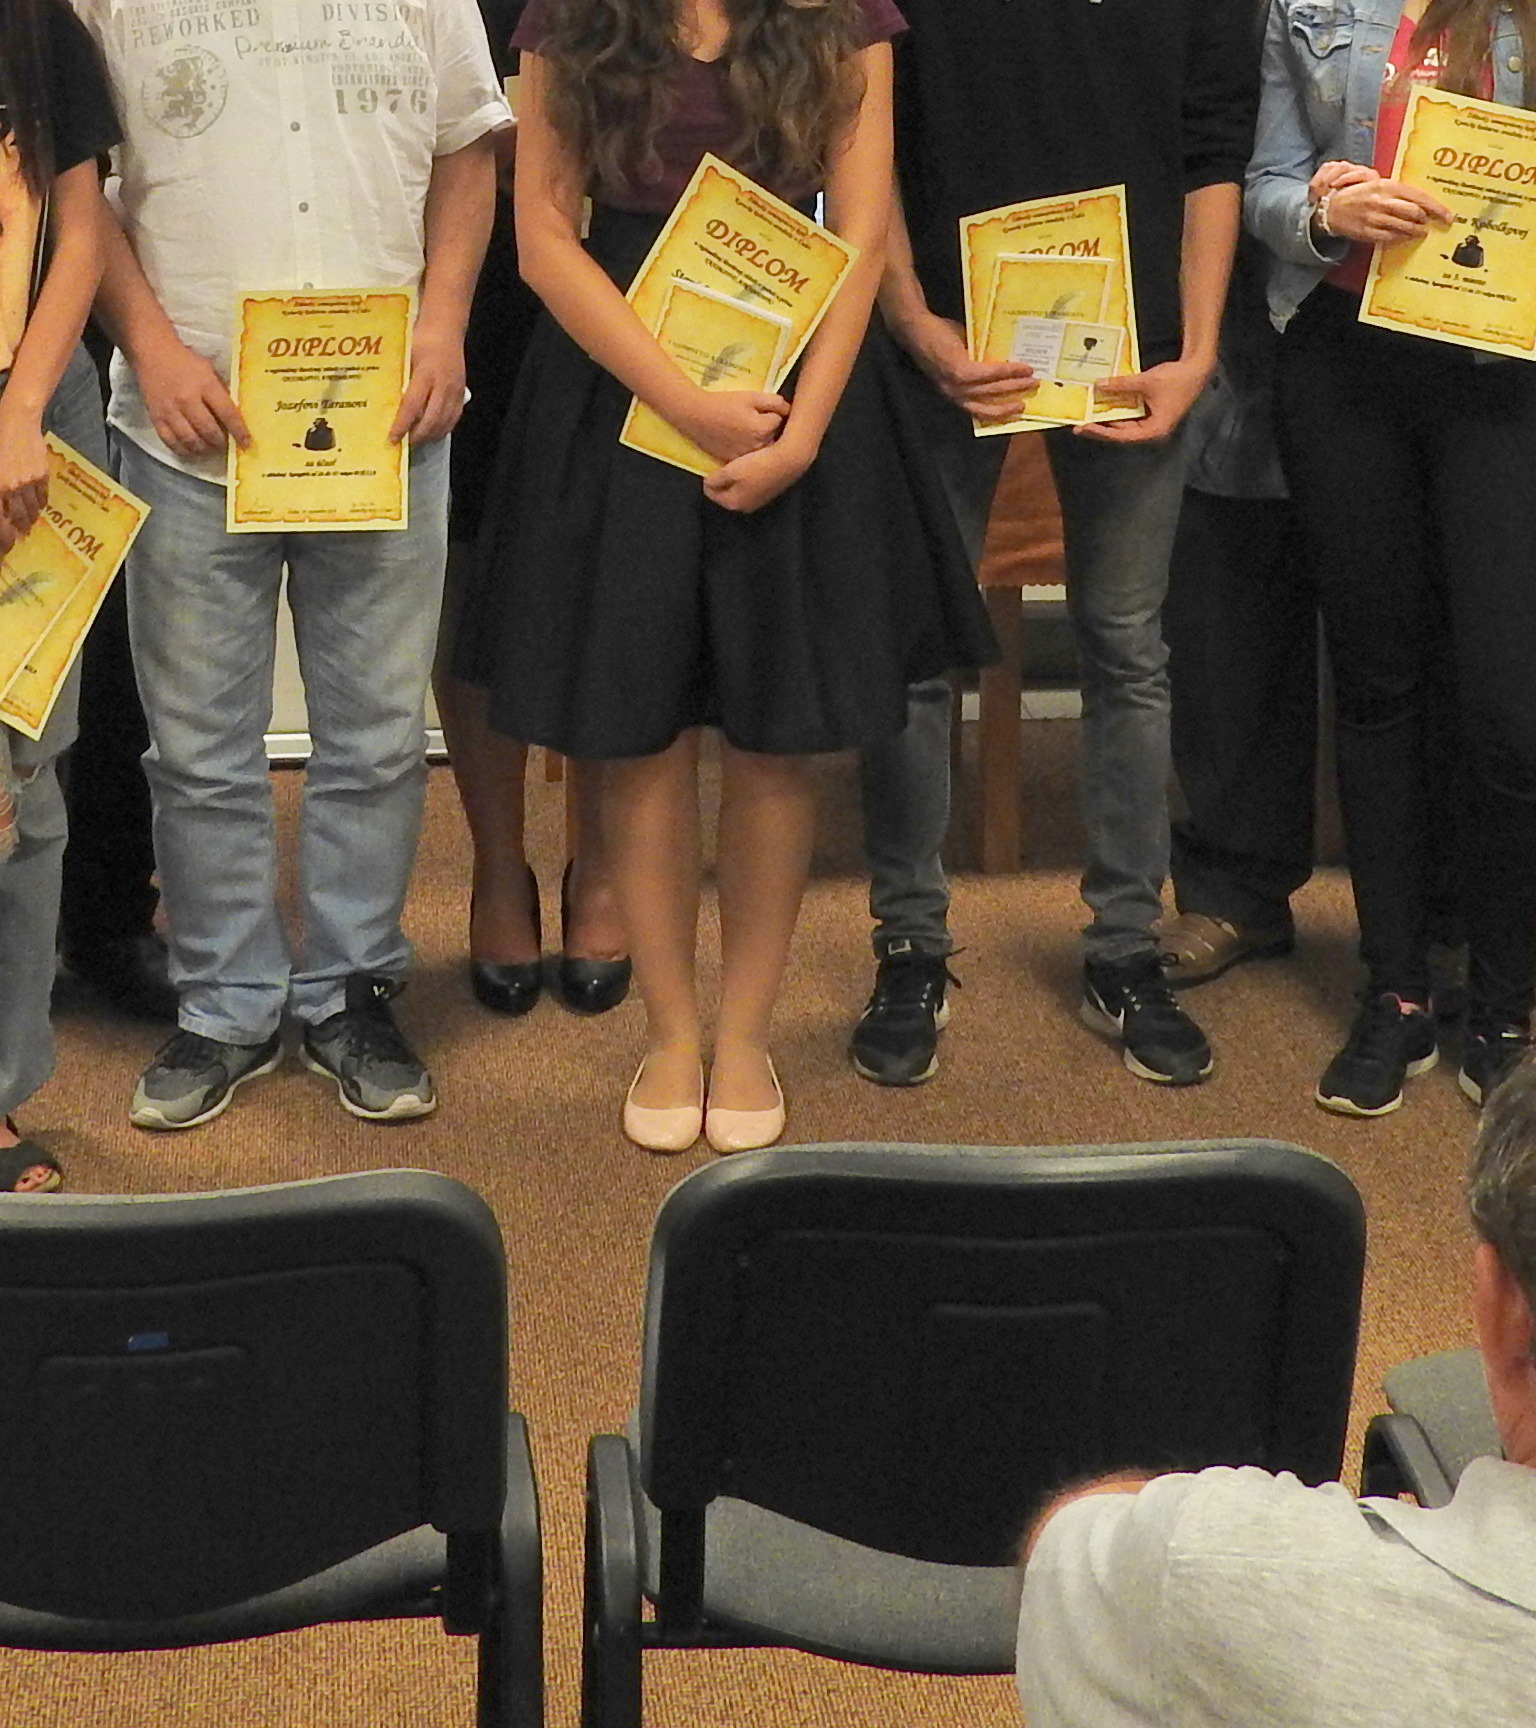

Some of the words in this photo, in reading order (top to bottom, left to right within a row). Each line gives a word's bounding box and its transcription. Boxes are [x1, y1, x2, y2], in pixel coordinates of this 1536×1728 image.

[132, 8, 261, 49] REWORKED
[335, 87, 428, 115] 1976
[705, 218, 811, 295] DIPLOM
[267, 335, 383, 358] DIPLOM
